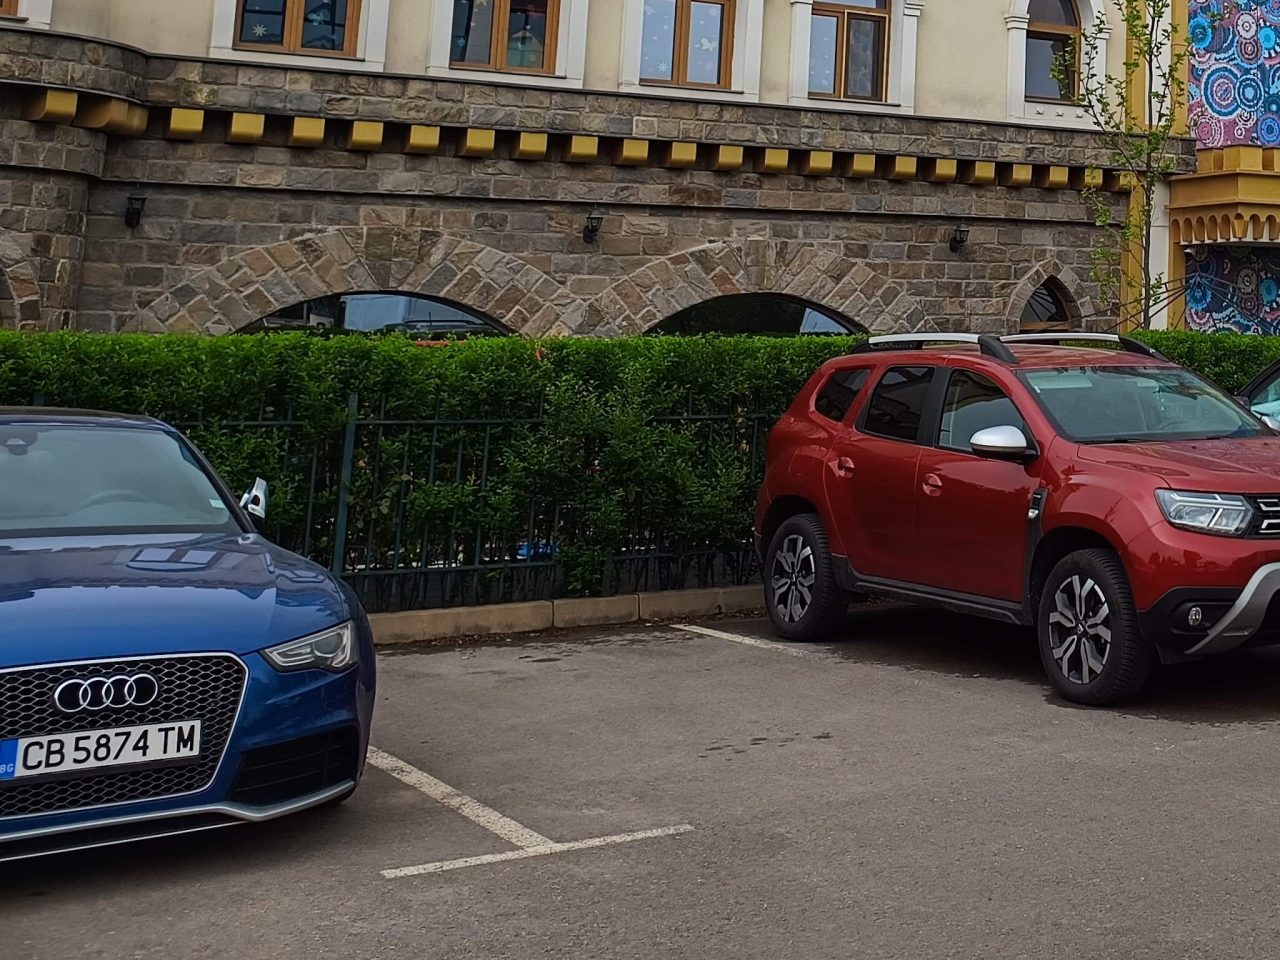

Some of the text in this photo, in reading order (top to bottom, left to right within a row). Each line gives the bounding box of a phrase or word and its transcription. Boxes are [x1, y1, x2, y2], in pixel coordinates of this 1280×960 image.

[22, 724, 195, 771] CB 5874 TM
